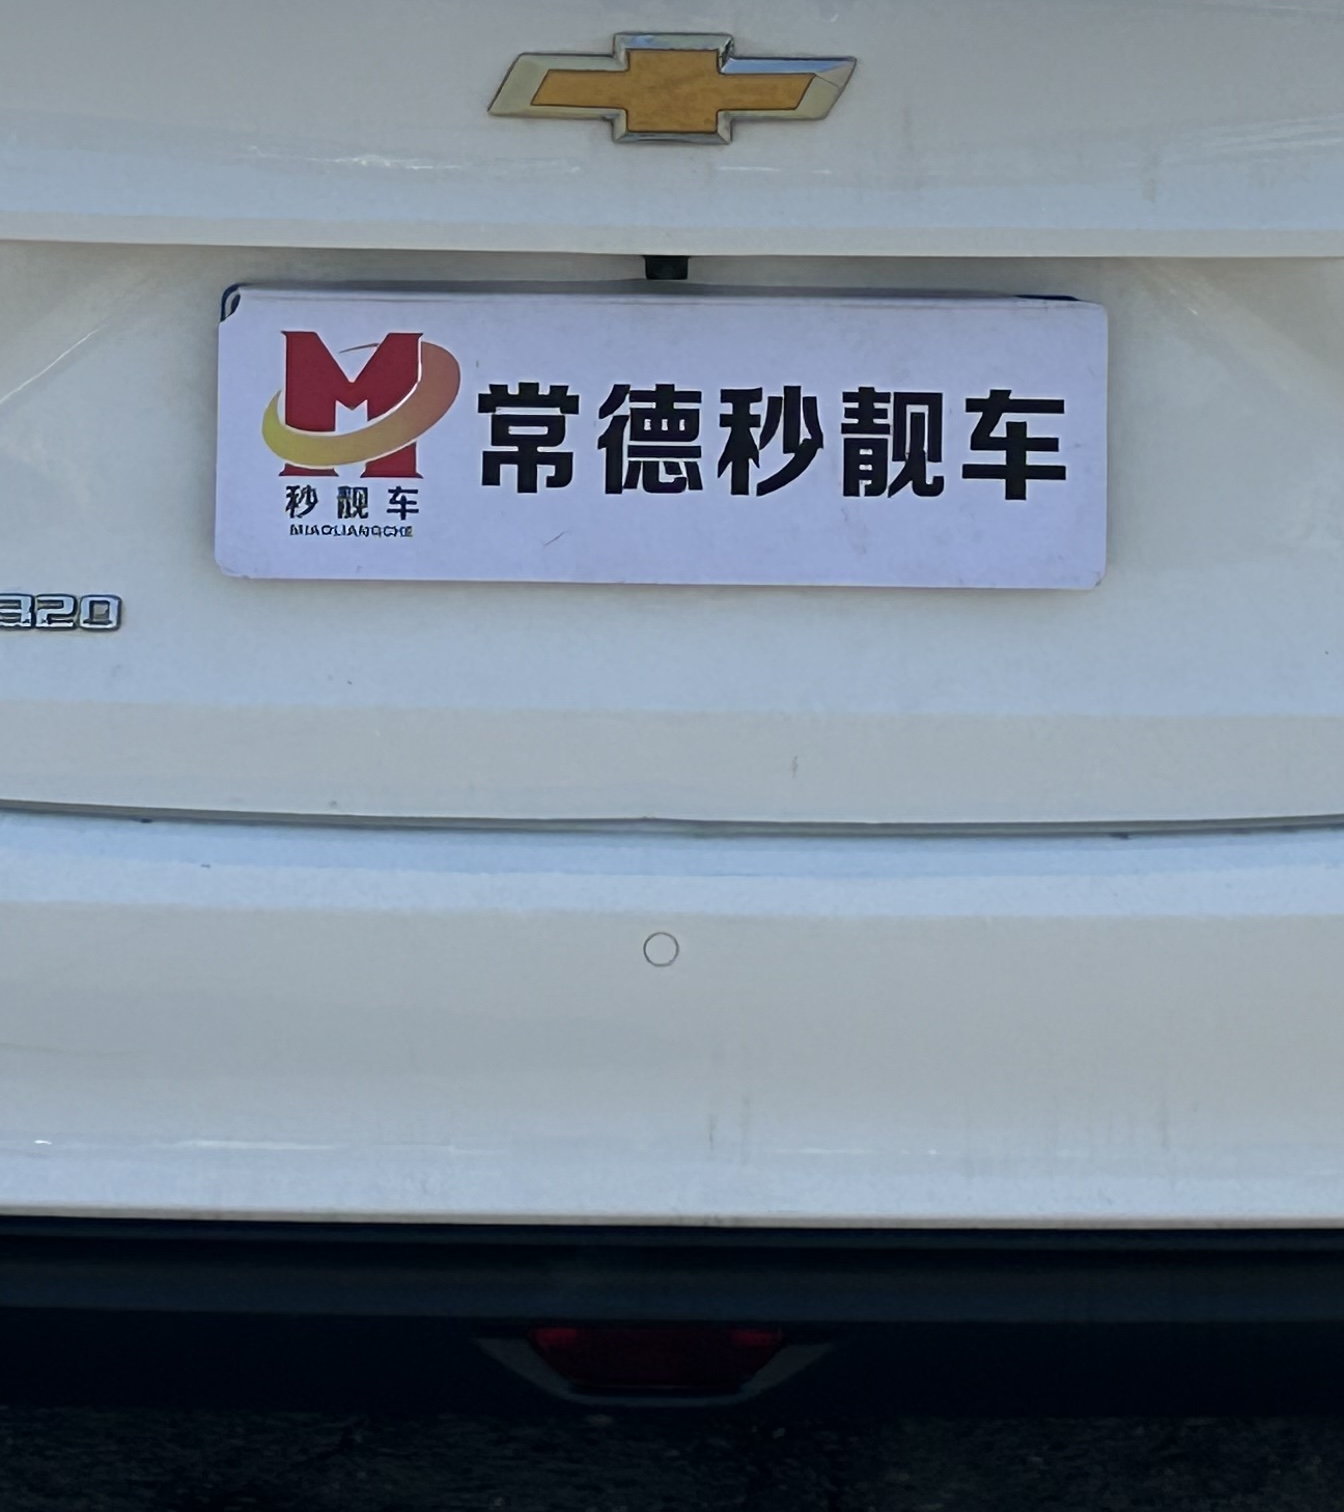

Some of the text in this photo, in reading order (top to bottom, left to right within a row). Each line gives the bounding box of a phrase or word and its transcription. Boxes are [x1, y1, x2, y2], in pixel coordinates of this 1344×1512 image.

[476, 381, 1068, 503] 常德秒靓车
[284, 484, 420, 521] 秒靓车
